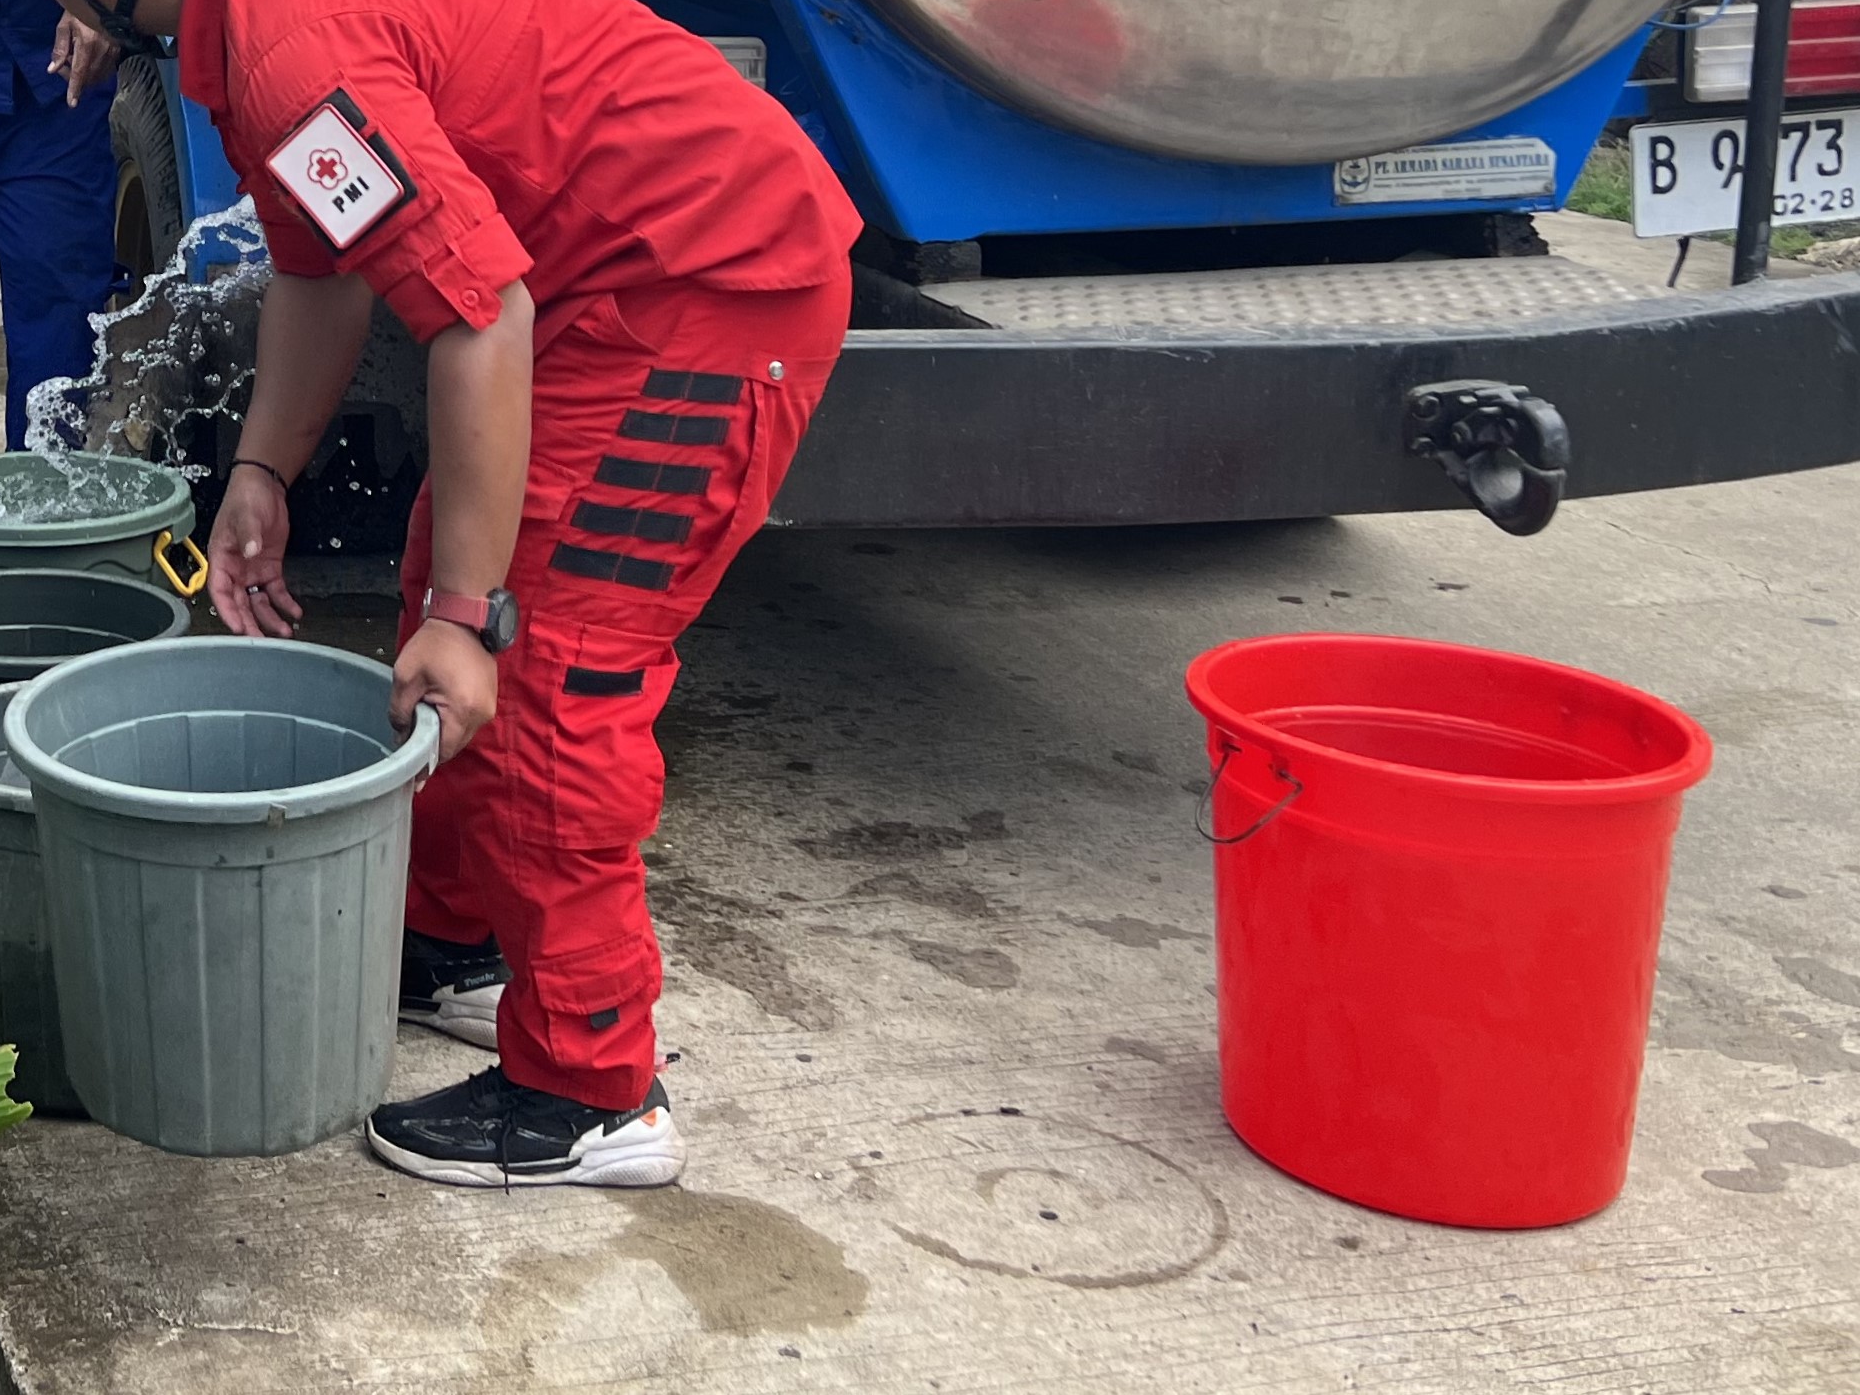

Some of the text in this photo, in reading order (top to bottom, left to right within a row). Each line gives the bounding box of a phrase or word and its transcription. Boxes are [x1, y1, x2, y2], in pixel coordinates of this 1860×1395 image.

[1392, 159, 1439, 174] ARMADA
[1649, 134, 1678, 195] B
[331, 175, 371, 214] PMI
